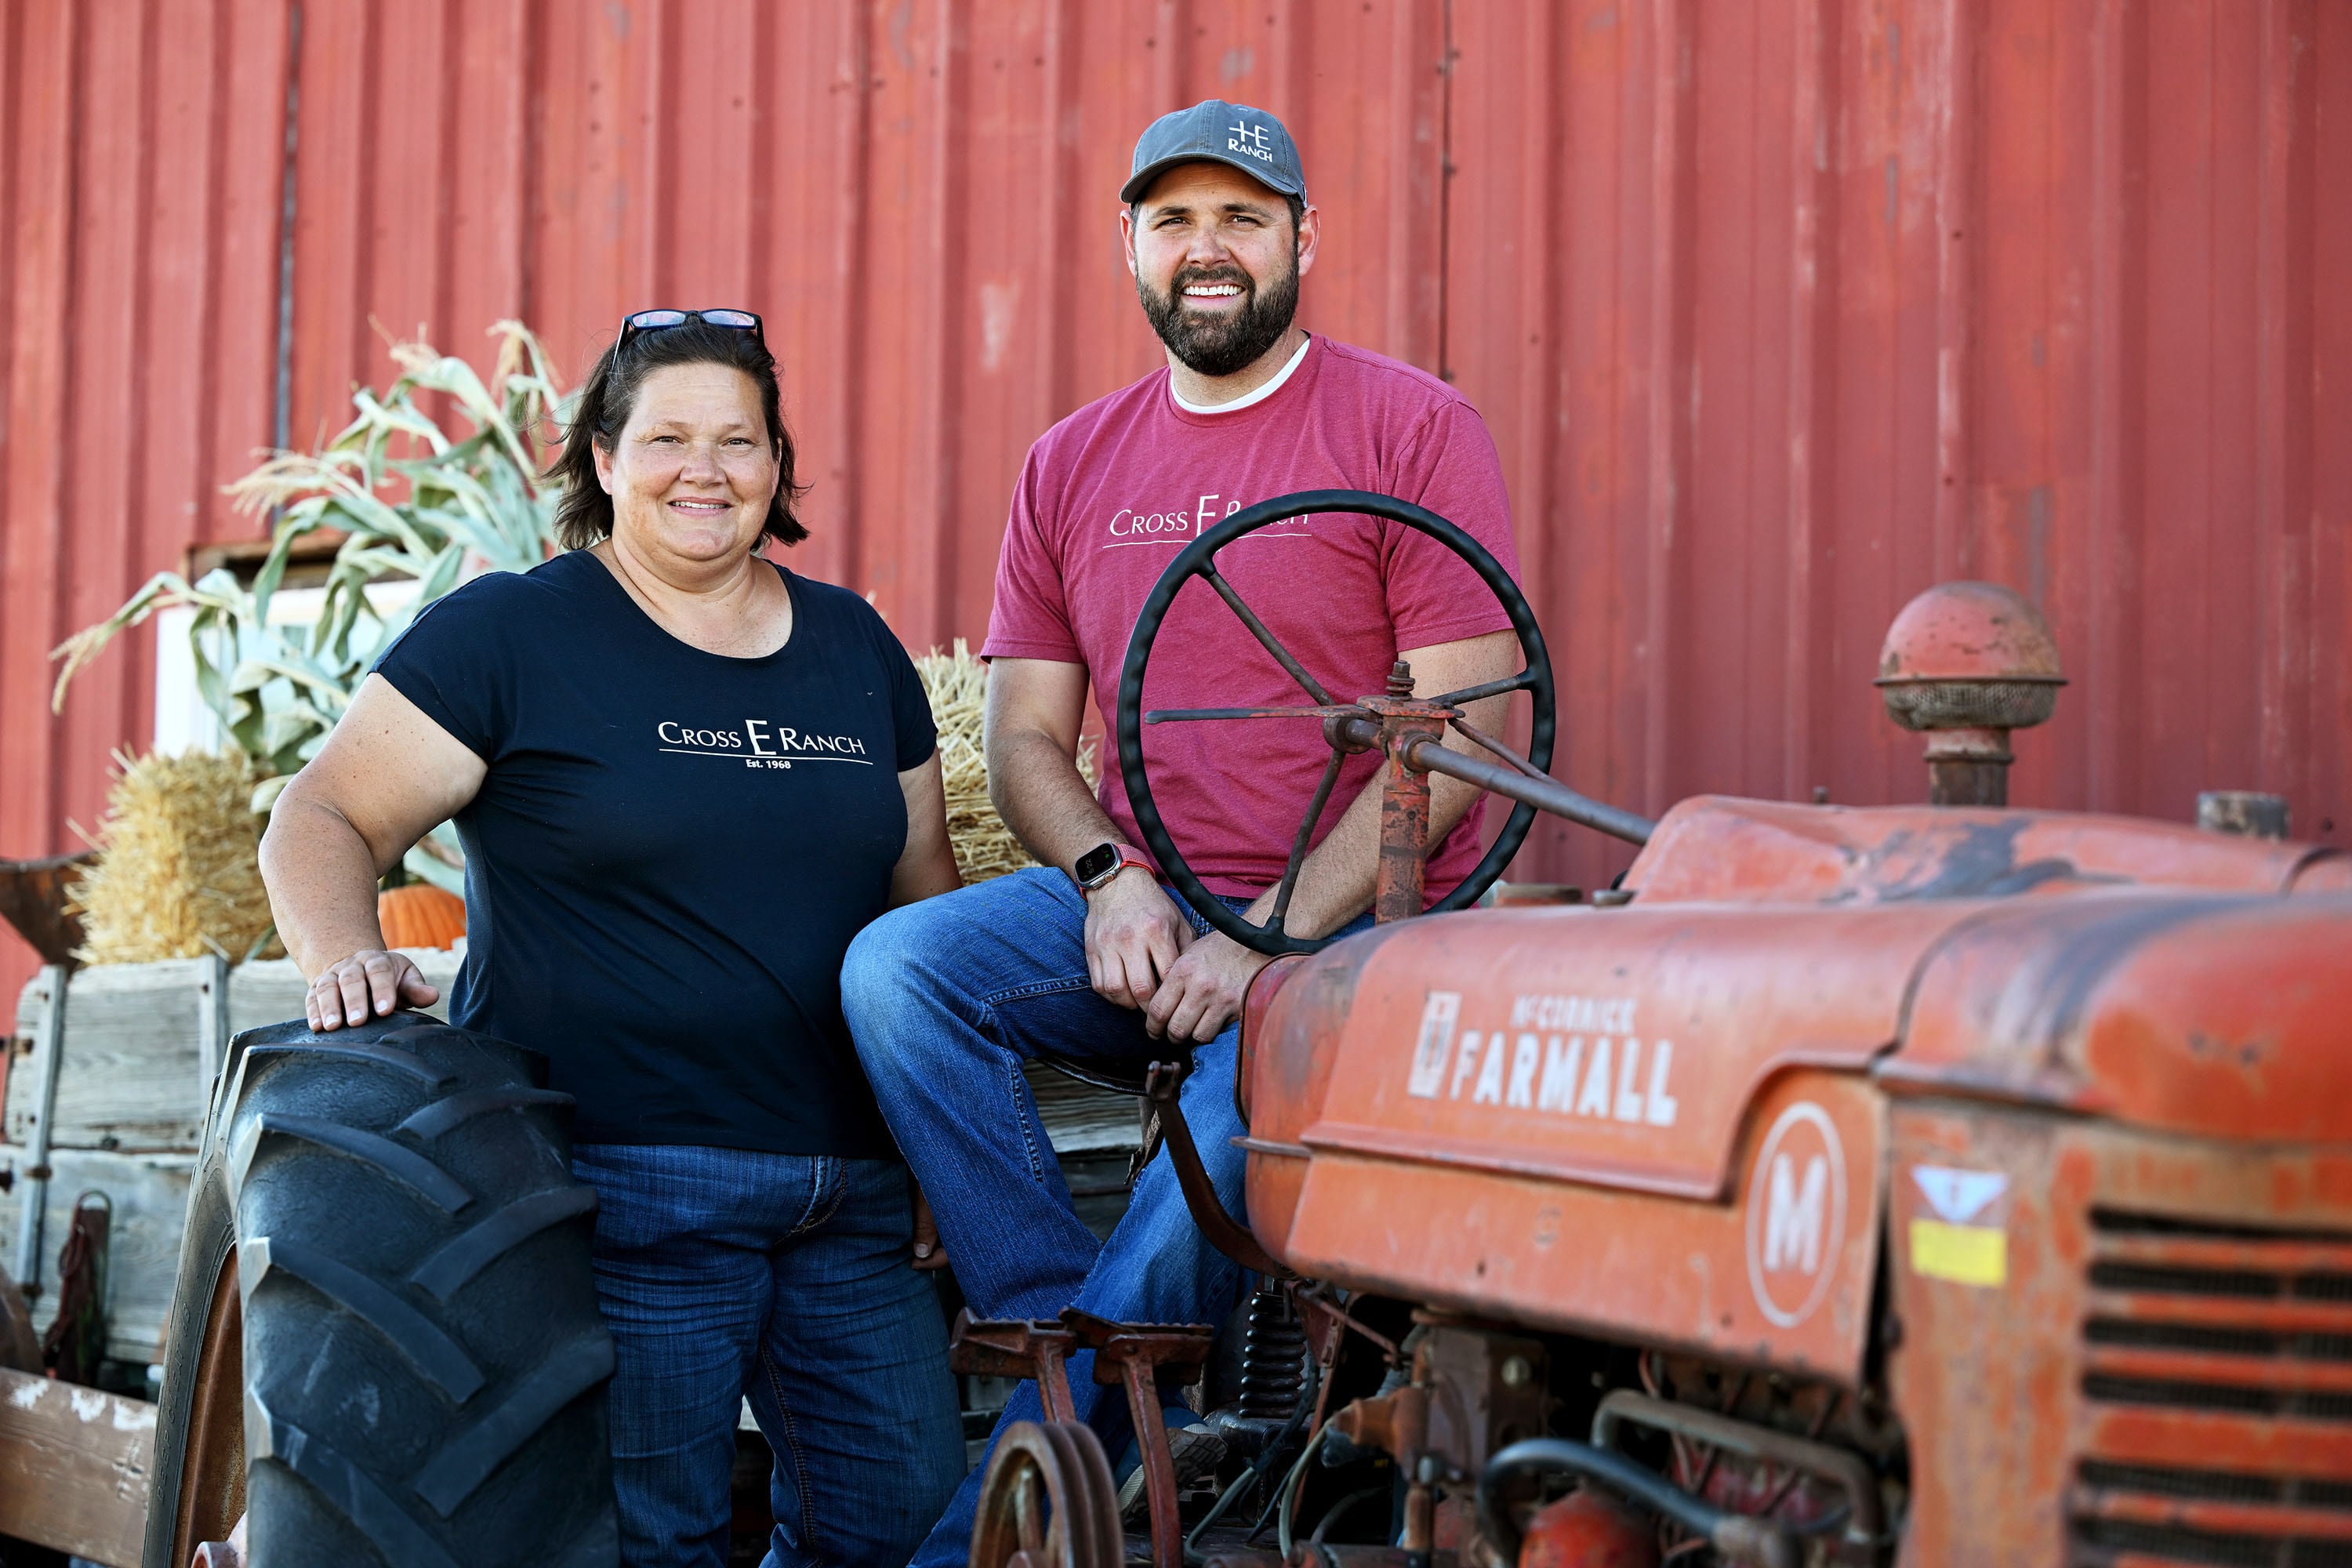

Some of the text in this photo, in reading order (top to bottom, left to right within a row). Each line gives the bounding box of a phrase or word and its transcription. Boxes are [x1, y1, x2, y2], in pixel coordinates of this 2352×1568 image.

[1229, 139, 1272, 162] RANCH
[746, 719, 777, 756] E
[746, 759, 791, 769] Est. 1968
[1450, 1029, 1678, 1128] FARMALL
[1764, 1151, 1827, 1274] M
